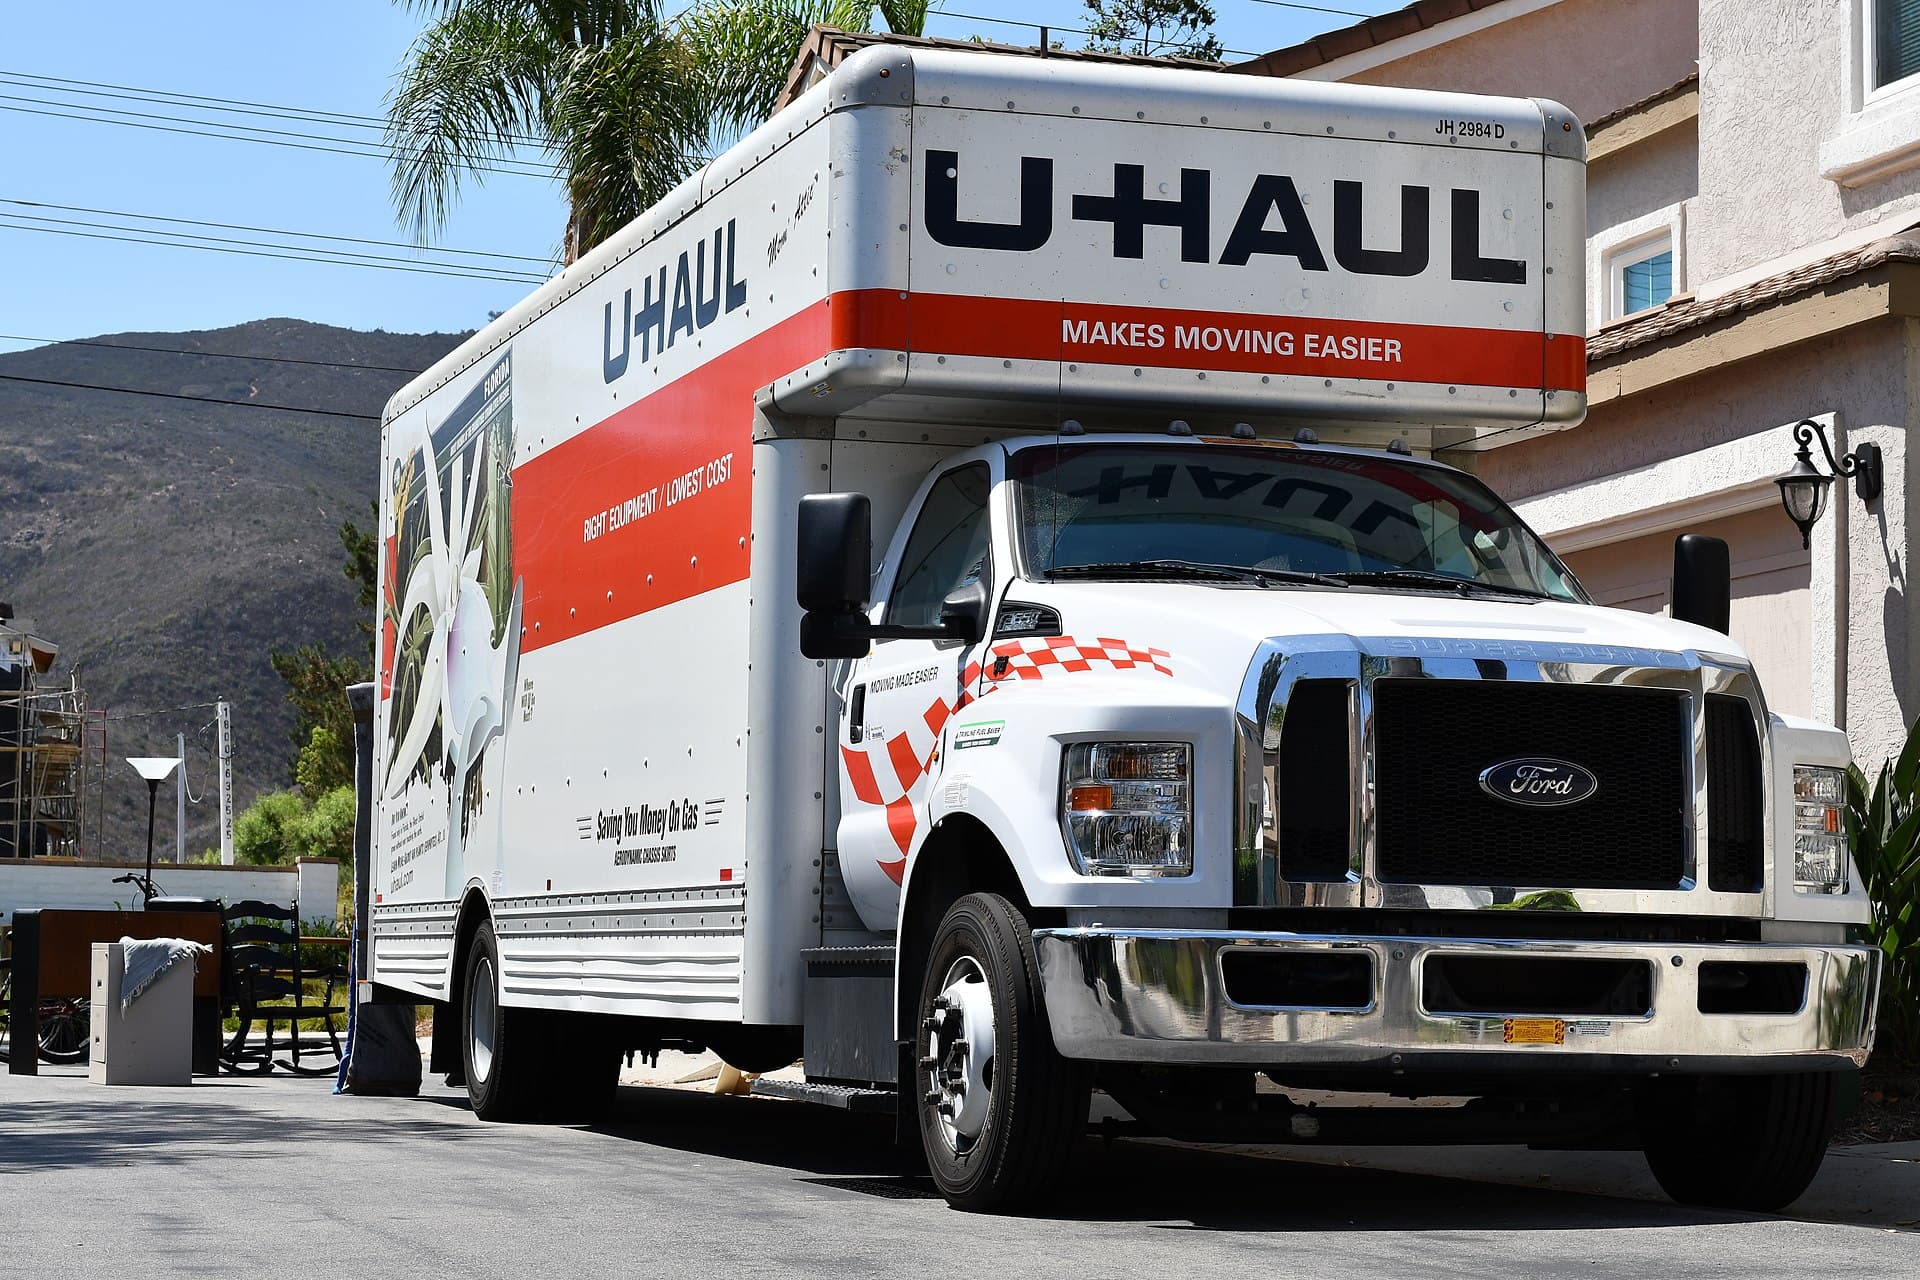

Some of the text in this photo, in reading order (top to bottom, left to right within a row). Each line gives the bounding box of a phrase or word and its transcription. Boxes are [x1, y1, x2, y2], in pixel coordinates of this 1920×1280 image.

[1435, 119, 1505, 139] JH 2984 D
[924, 149, 1527, 285] U-HAUL
[603, 217, 747, 384] U-HAUL
[1062, 319, 1402, 362] MAKES MOVING EASIER
[484, 357, 510, 401] FLORIDA
[583, 510, 608, 543] RIGHT
[609, 487, 658, 532] EQUIPMENT
[667, 465, 705, 507] LOWEST
[706, 452, 733, 489] COST
[1386, 638, 1668, 665] SUPER DUTY
[870, 666, 939, 694] MOVING MADE EASIER
[1510, 765, 1574, 794] Ford
[624, 806, 639, 837] You
[639, 803, 668, 841] Money
[668, 799, 680, 833] On
[682, 797, 698, 831] Gas
[613, 845, 677, 866] AERODYNAMIC CHASSIS SKIRTS
